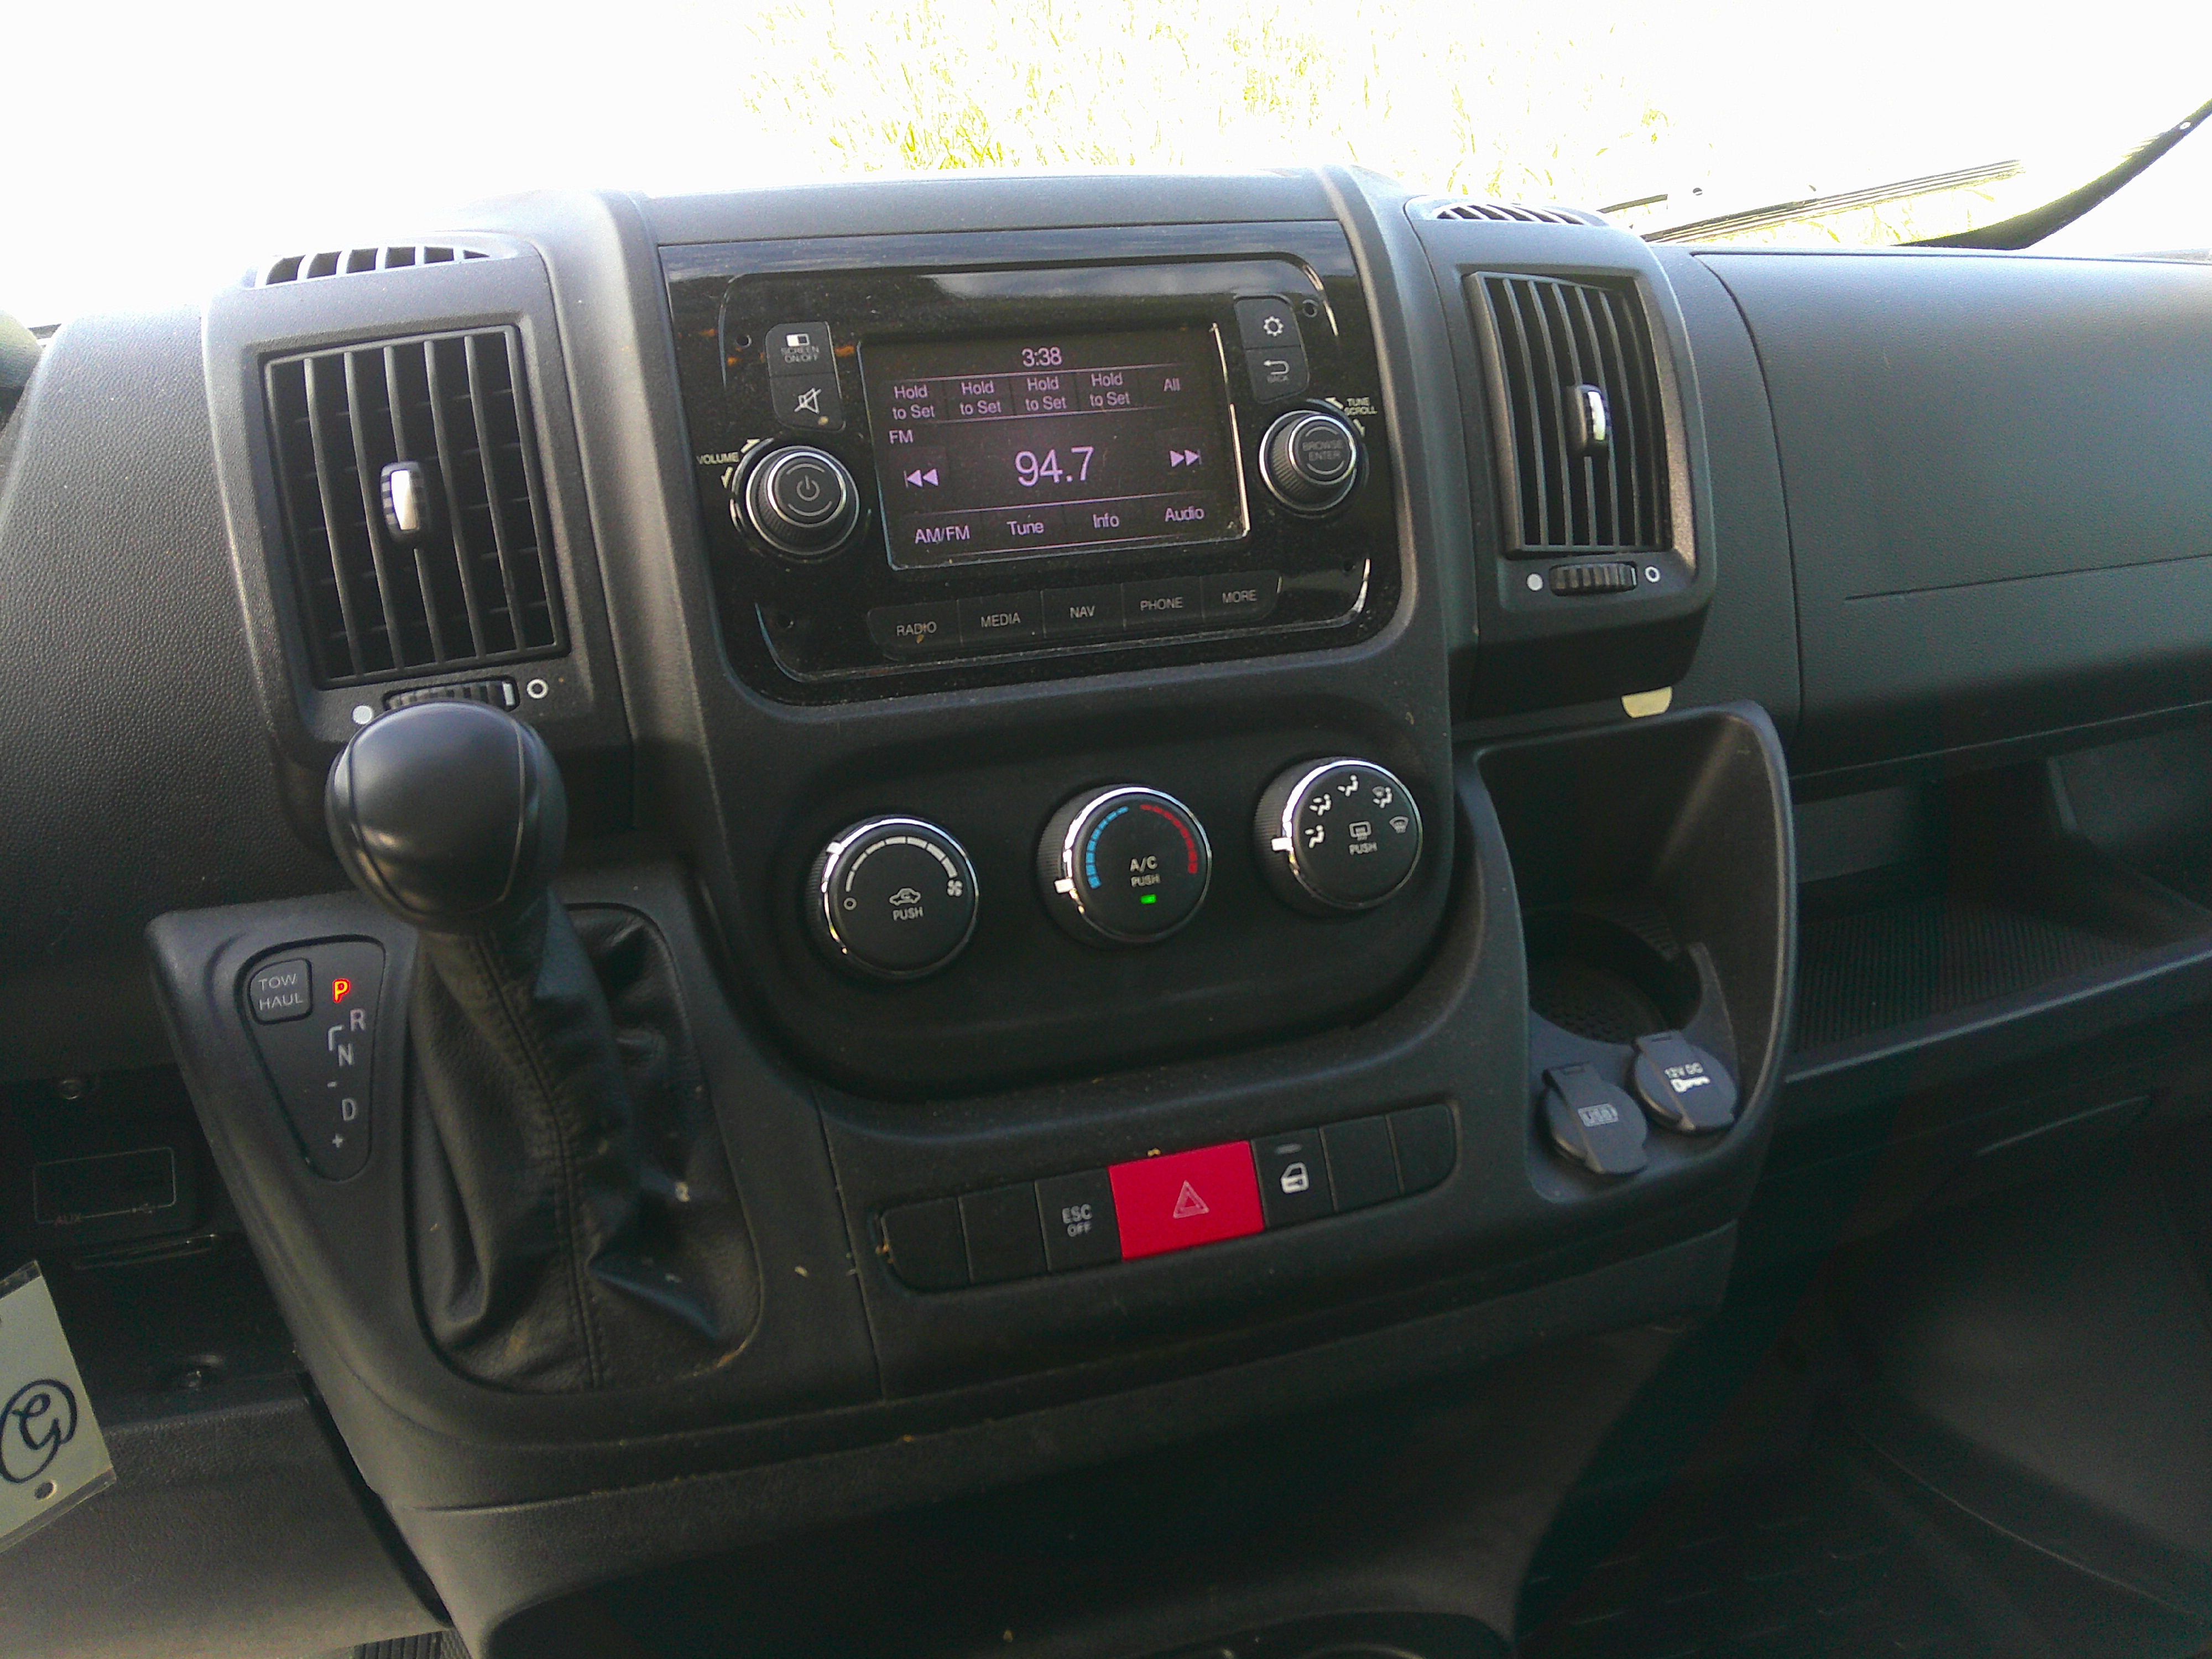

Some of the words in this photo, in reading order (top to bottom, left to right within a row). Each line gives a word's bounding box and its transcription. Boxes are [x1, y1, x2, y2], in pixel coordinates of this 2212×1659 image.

[1021, 346, 1062, 367] 3:38
[961, 380, 995, 395] Hold
[1026, 376, 1060, 392] Hold
[1091, 372, 1123, 388] Hold
[1164, 378, 1181, 392] All
[894, 384, 928, 399] Hold
[1089, 394, 1104, 407] to
[1106, 391, 1131, 406] Set
[959, 402, 974, 416] to
[977, 399, 1001, 414] Set
[1025, 398, 1039, 411] to
[1043, 395, 1067, 410] Set
[1346, 397, 1371, 407] TUNE
[892, 406, 906, 420] to
[910, 404, 935, 419] Set
[1344, 405, 1378, 416] SCROLL
[888, 429, 914, 444] FM
[696, 451, 739, 465] VOLUME
[1014, 445, 1094, 487] 94.7
[1093, 513, 1120, 529] Info
[1164, 505, 1205, 522] Audio
[915, 525, 971, 544] AM/FM
[1006, 520, 1045, 536] Tune
[1140, 597, 1183, 611] PHONE
[1222, 589, 1258, 604] MORE
[980, 612, 1021, 628] MEDIA
[1070, 605, 1095, 619] NAV
[896, 621, 937, 637] RADIO
[1349, 841, 1378, 855] PUSH
[1130, 855, 1159, 873] A/C
[1131, 873, 1161, 888] PUSH
[893, 906, 924, 922] PUSH
[258, 973, 298, 991] TOW
[332, 978, 351, 1003] P
[259, 993, 304, 1011] HAUL
[349, 1008, 367, 1032] R
[337, 1043, 355, 1067] N
[341, 1098, 357, 1121] D
[1062, 1203, 1093, 1224] ESC
[1067, 1220, 1092, 1238] OFF
